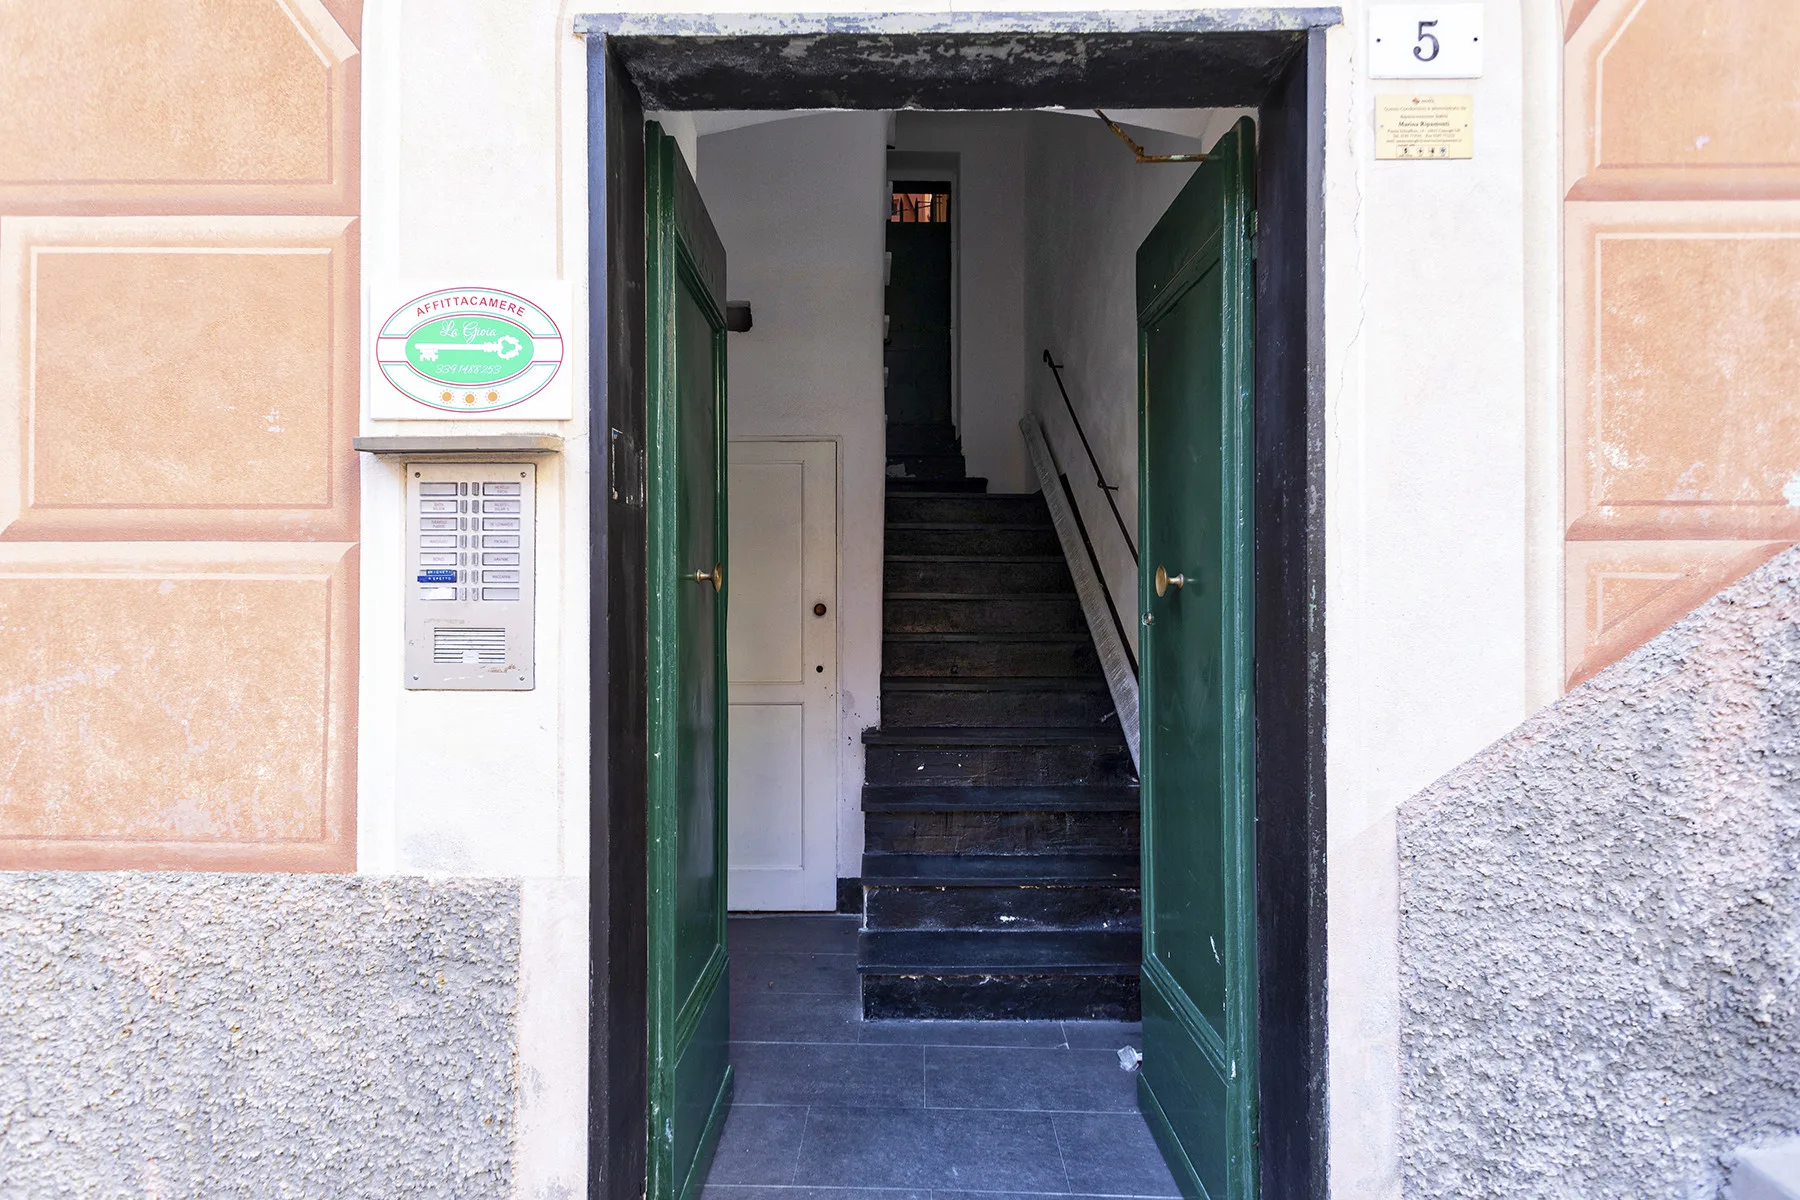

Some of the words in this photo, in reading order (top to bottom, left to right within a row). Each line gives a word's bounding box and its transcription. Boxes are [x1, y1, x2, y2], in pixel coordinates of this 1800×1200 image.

[1413, 19, 1440, 62] 5
[416, 296, 526, 317] AFFITTACAMERE
[440, 319, 458, 337] La
[462, 319, 497, 345] Gioia
